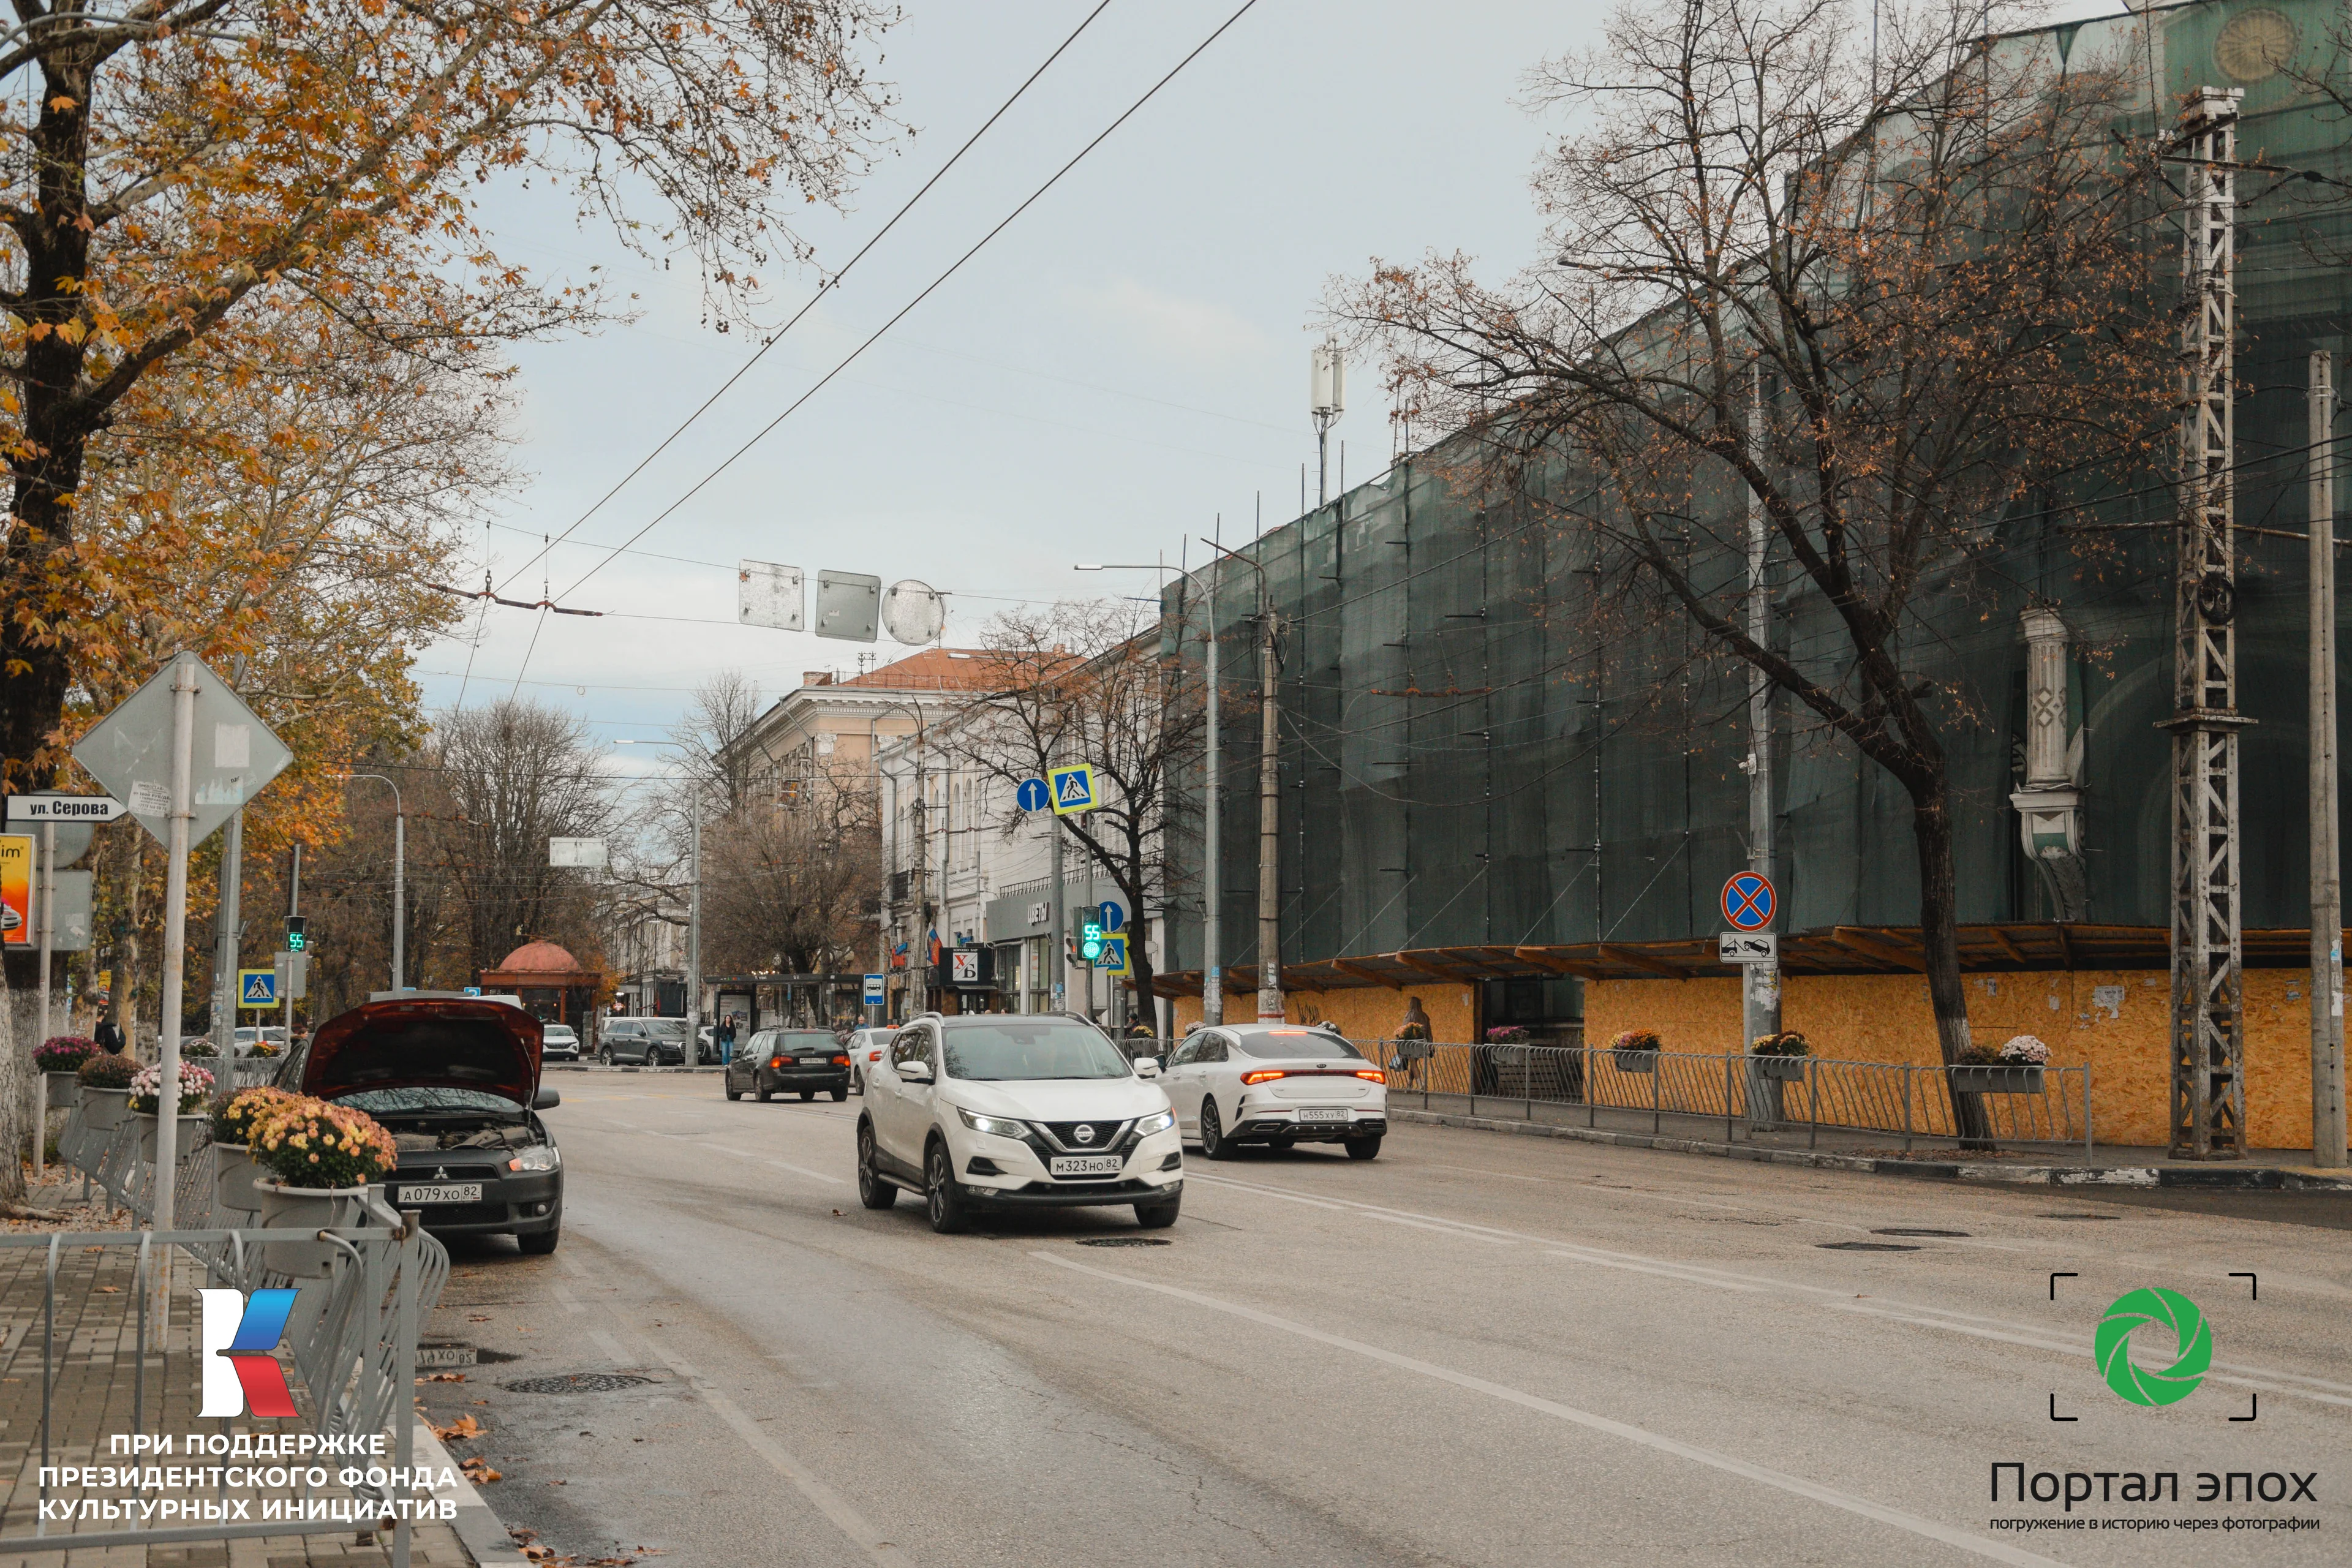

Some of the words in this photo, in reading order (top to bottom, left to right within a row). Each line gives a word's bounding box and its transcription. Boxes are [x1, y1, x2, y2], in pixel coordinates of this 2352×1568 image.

[30, 804, 49, 815] ул.
[53, 801, 108, 816] Серова
[1028, 902, 1047, 926] ЦВЕТЫ
[1084, 924, 1100, 940] 55
[290, 933, 304, 948] 55
[1303, 1111, 1335, 1120] Н555ХУ
[1056, 1159, 1104, 1172] М323НО
[1106, 1158, 1117, 1167] 82
[404, 1188, 460, 1201] А079ХО
[464, 1186, 477, 1196] 82
